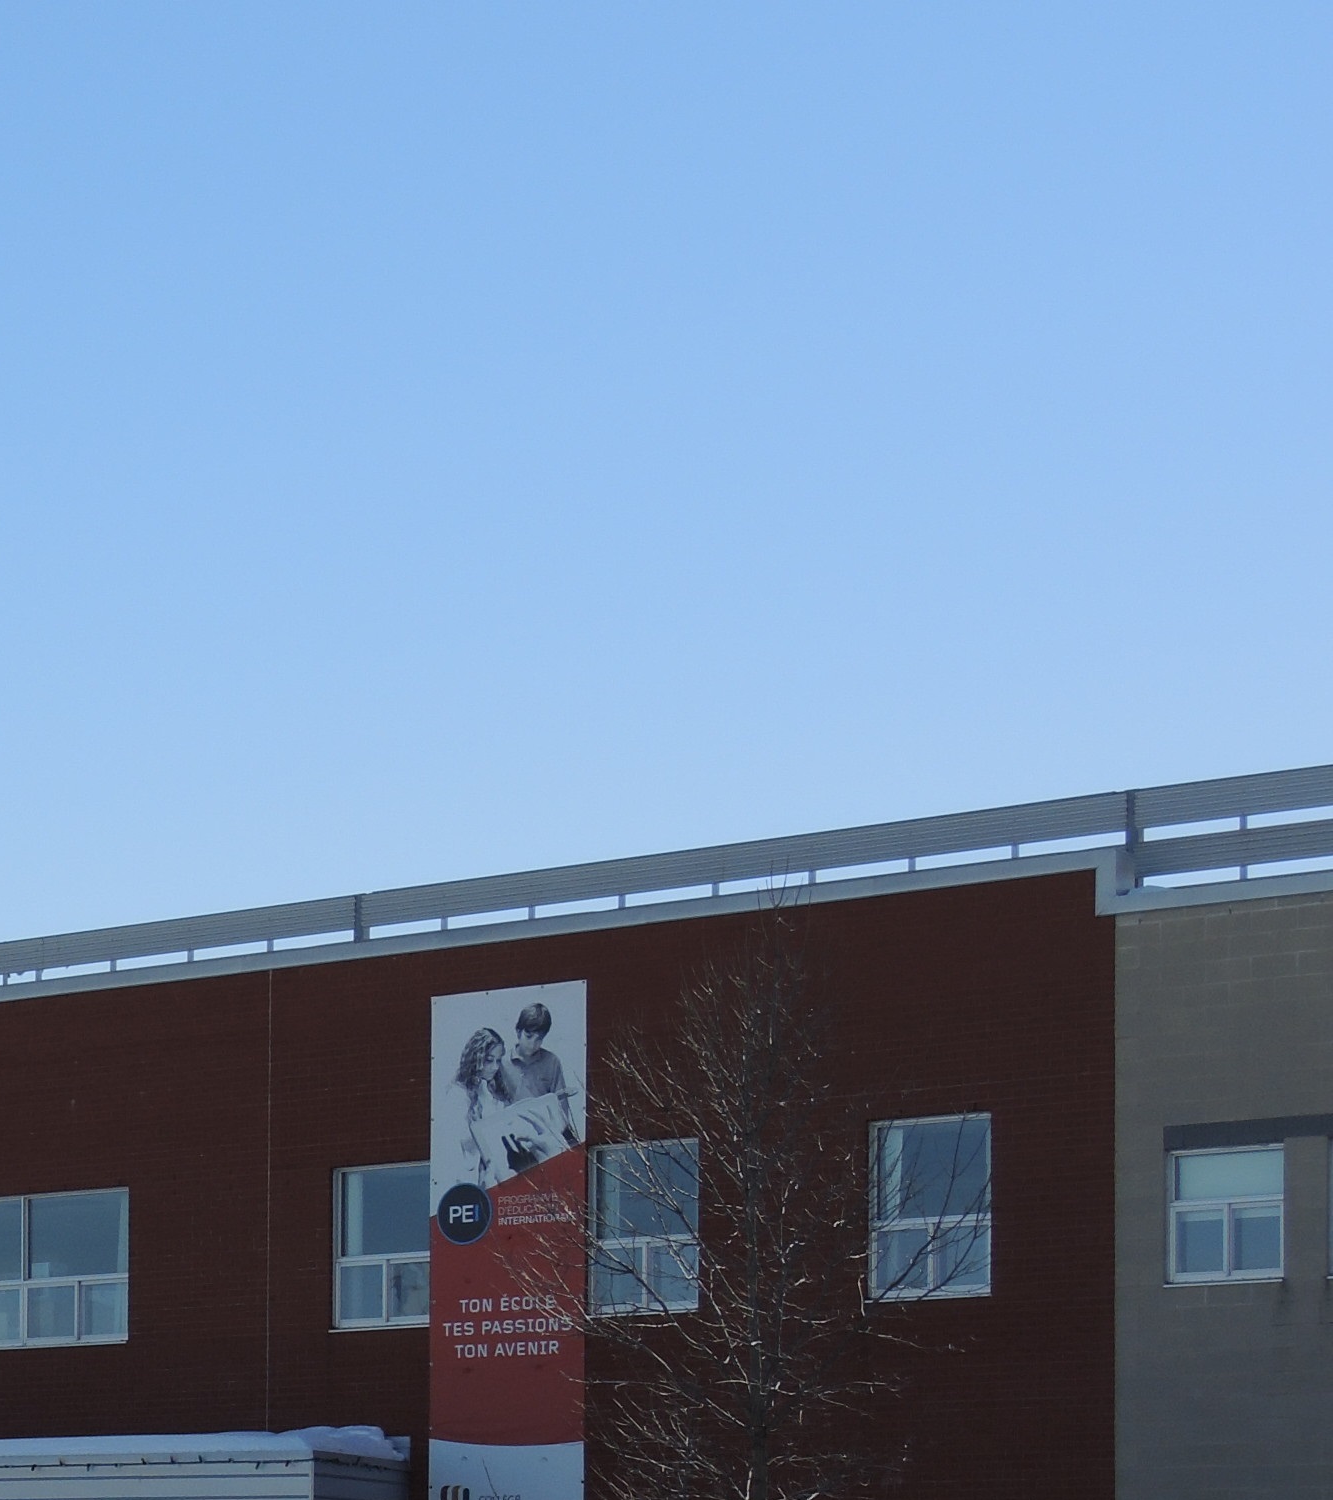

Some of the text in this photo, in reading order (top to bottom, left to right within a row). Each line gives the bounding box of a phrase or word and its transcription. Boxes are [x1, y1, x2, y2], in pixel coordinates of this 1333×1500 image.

[498, 1193, 559, 1206] PROGRE
[449, 1203, 480, 1225] PEI
[498, 1212, 576, 1226] INTERNATION
[459, 1293, 556, 1314] TON ÉCOLE
[443, 1317, 573, 1337] TES PASSIONS
[455, 1340, 560, 1359] TON AVENIR
